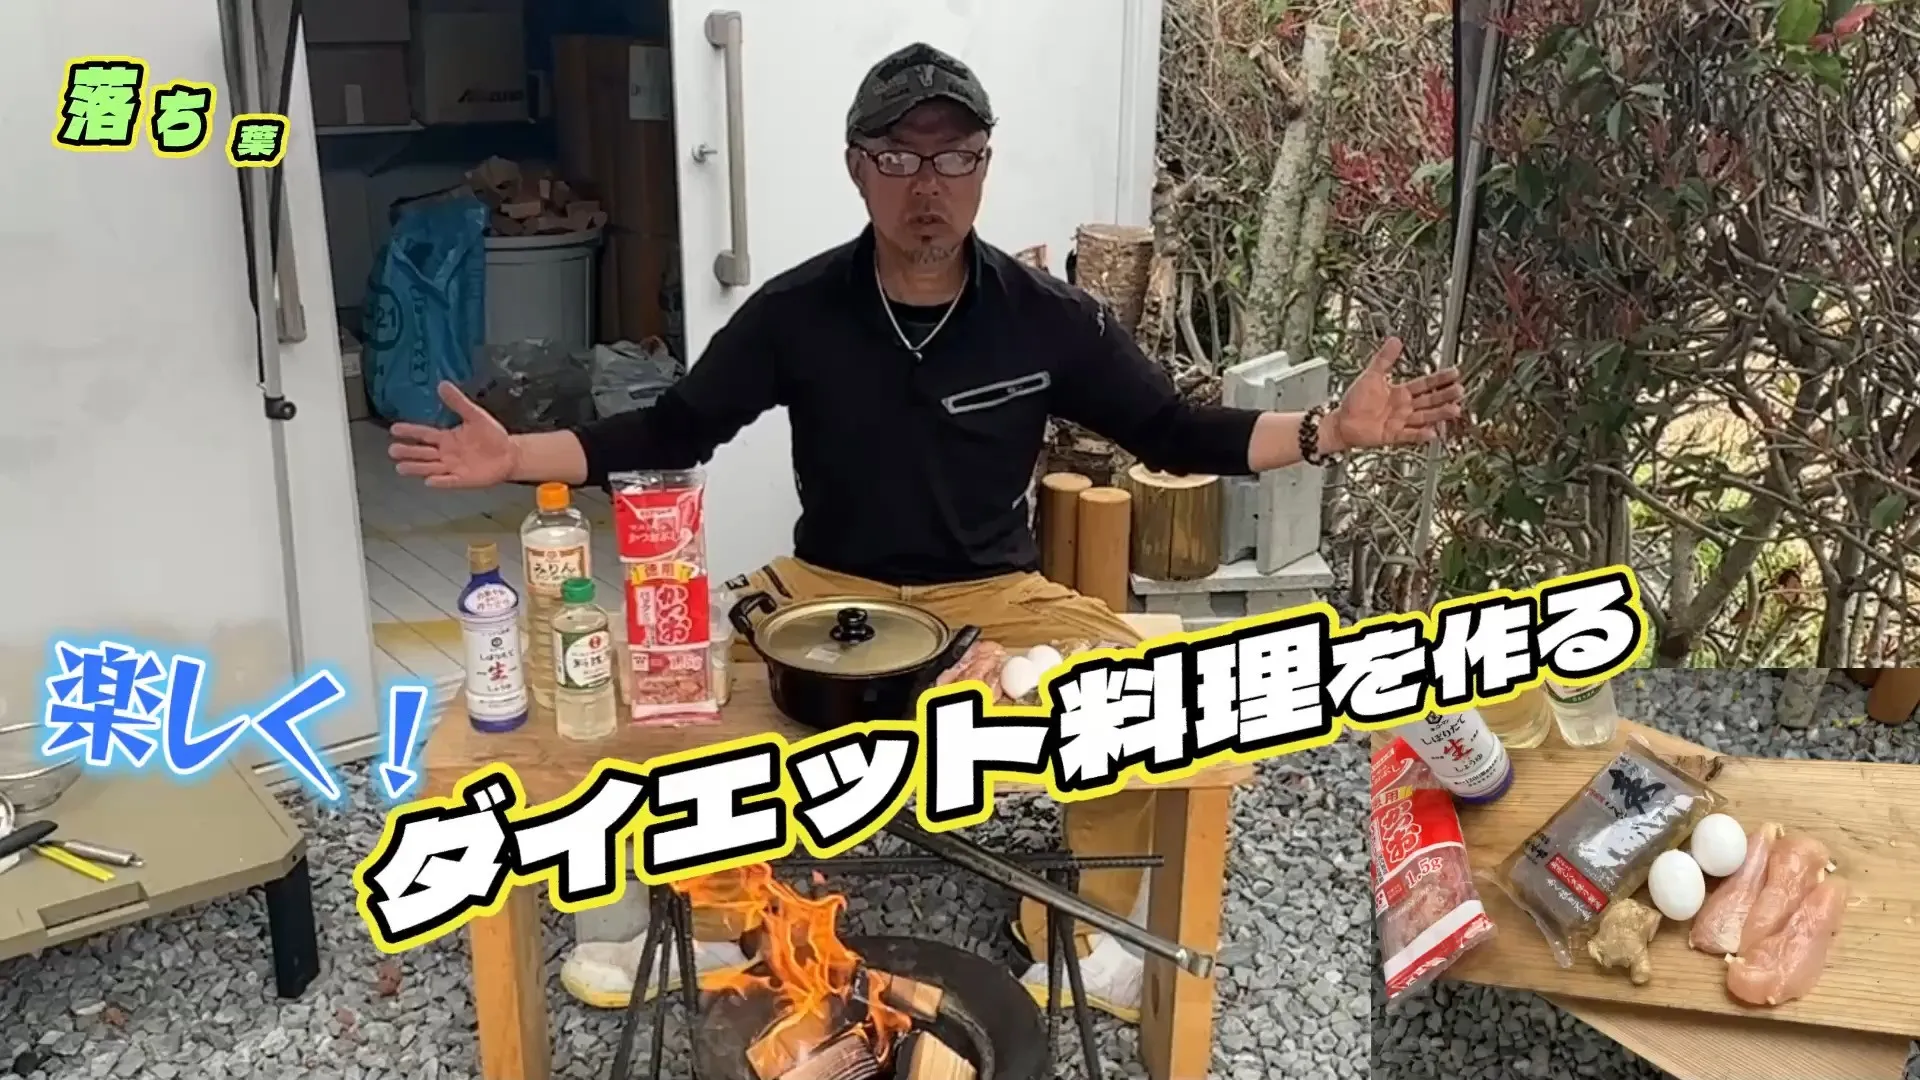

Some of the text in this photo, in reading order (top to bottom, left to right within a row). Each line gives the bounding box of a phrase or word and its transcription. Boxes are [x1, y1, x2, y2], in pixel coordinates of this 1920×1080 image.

[534, 562, 576, 577] みりん
[645, 562, 675, 578] 徳用
[657, 584, 693, 644] かつお
[487, 661, 509, 682] 生
[1421, 713, 1466, 746] しぼりたて
[1443, 737, 1474, 761] 生
[1454, 753, 1483, 772] しょうゆ
[1381, 801, 1421, 863] かつお
[1405, 856, 1443, 889] 1.5g
